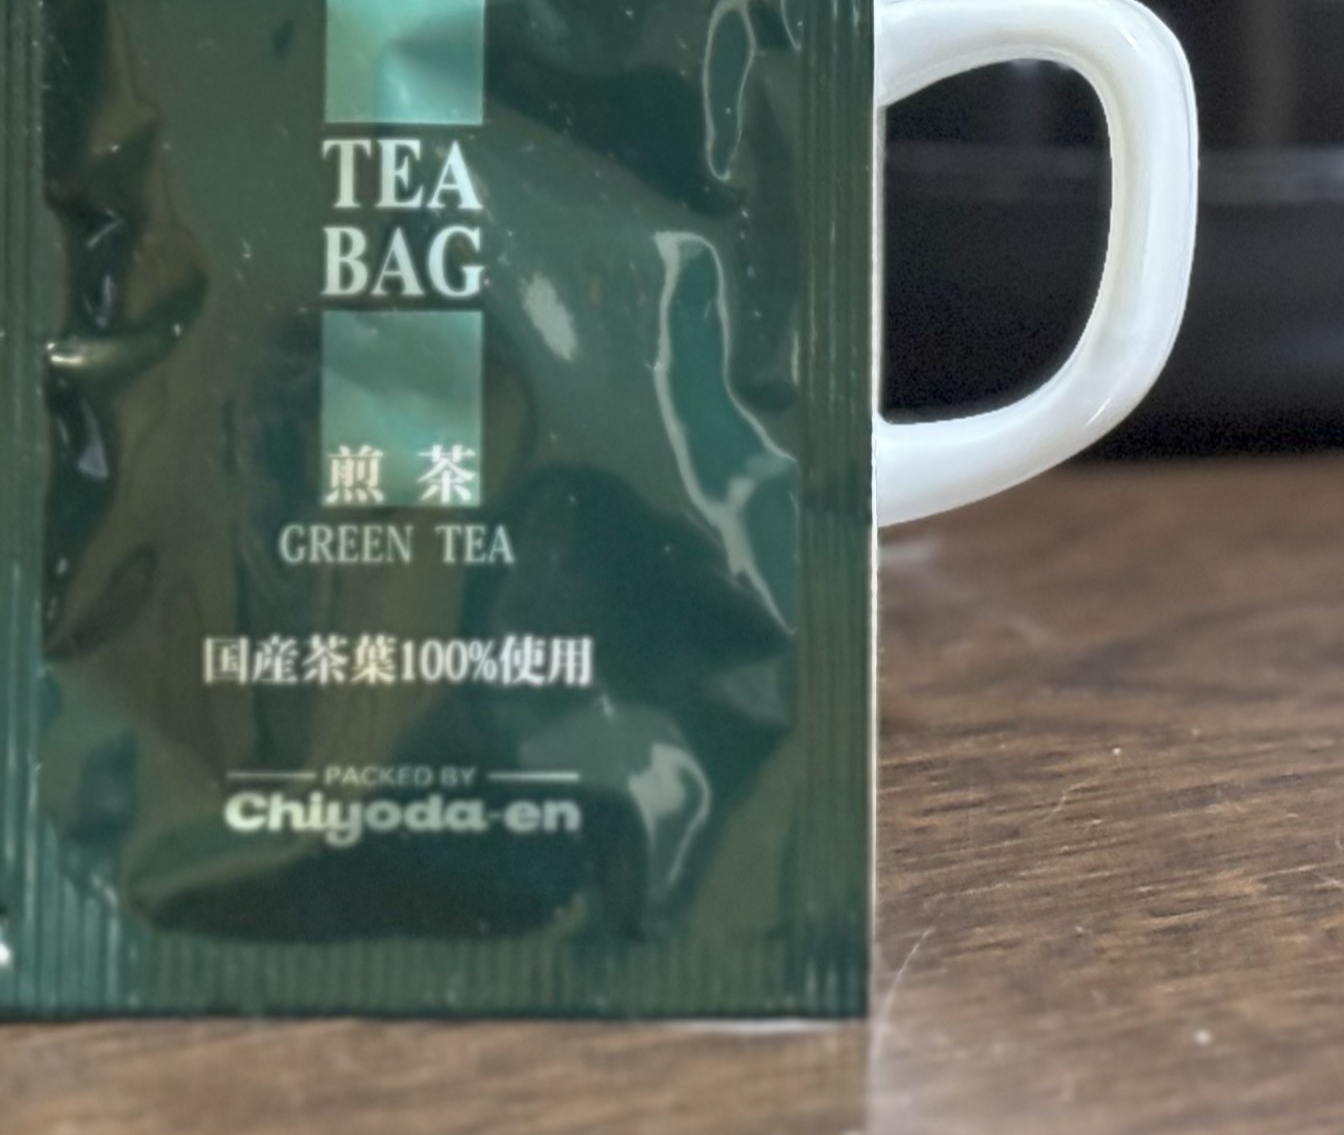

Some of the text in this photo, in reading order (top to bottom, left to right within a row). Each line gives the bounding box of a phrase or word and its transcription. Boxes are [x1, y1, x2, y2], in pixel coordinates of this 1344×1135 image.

[321, 138, 485, 210] TEA
[321, 225, 486, 298] BAG
[277, 523, 516, 565] GREEN TEA
[203, 633, 594, 686] 国産茶葉100%使用
[323, 765, 477, 788] PACKED BY
[224, 792, 582, 847] Chiyoda-en
